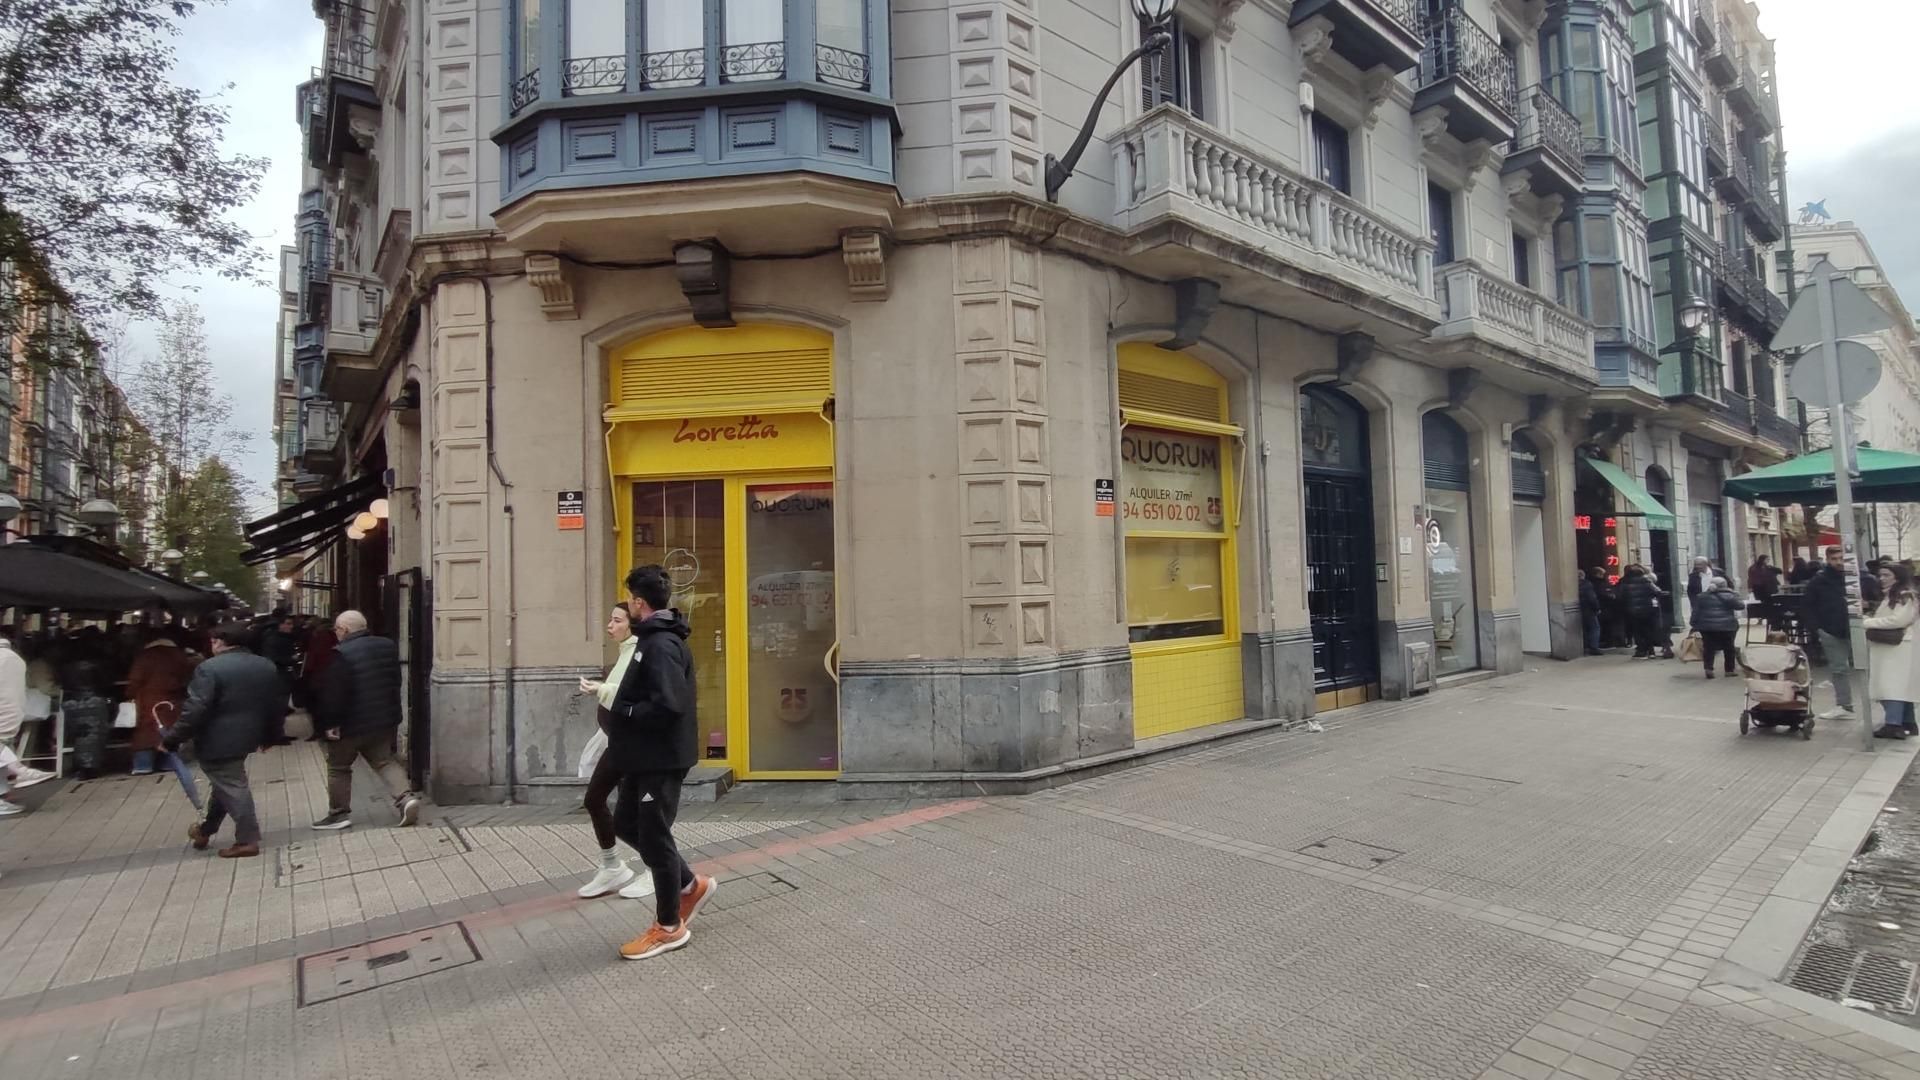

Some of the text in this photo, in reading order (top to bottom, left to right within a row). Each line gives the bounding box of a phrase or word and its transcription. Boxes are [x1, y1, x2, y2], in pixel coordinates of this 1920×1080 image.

[673, 415, 779, 443] Loretta
[1121, 437, 1217, 470] QUORUM
[1129, 487, 1171, 500] ALQUILER
[1123, 502, 1201, 521] 94 651 02 02
